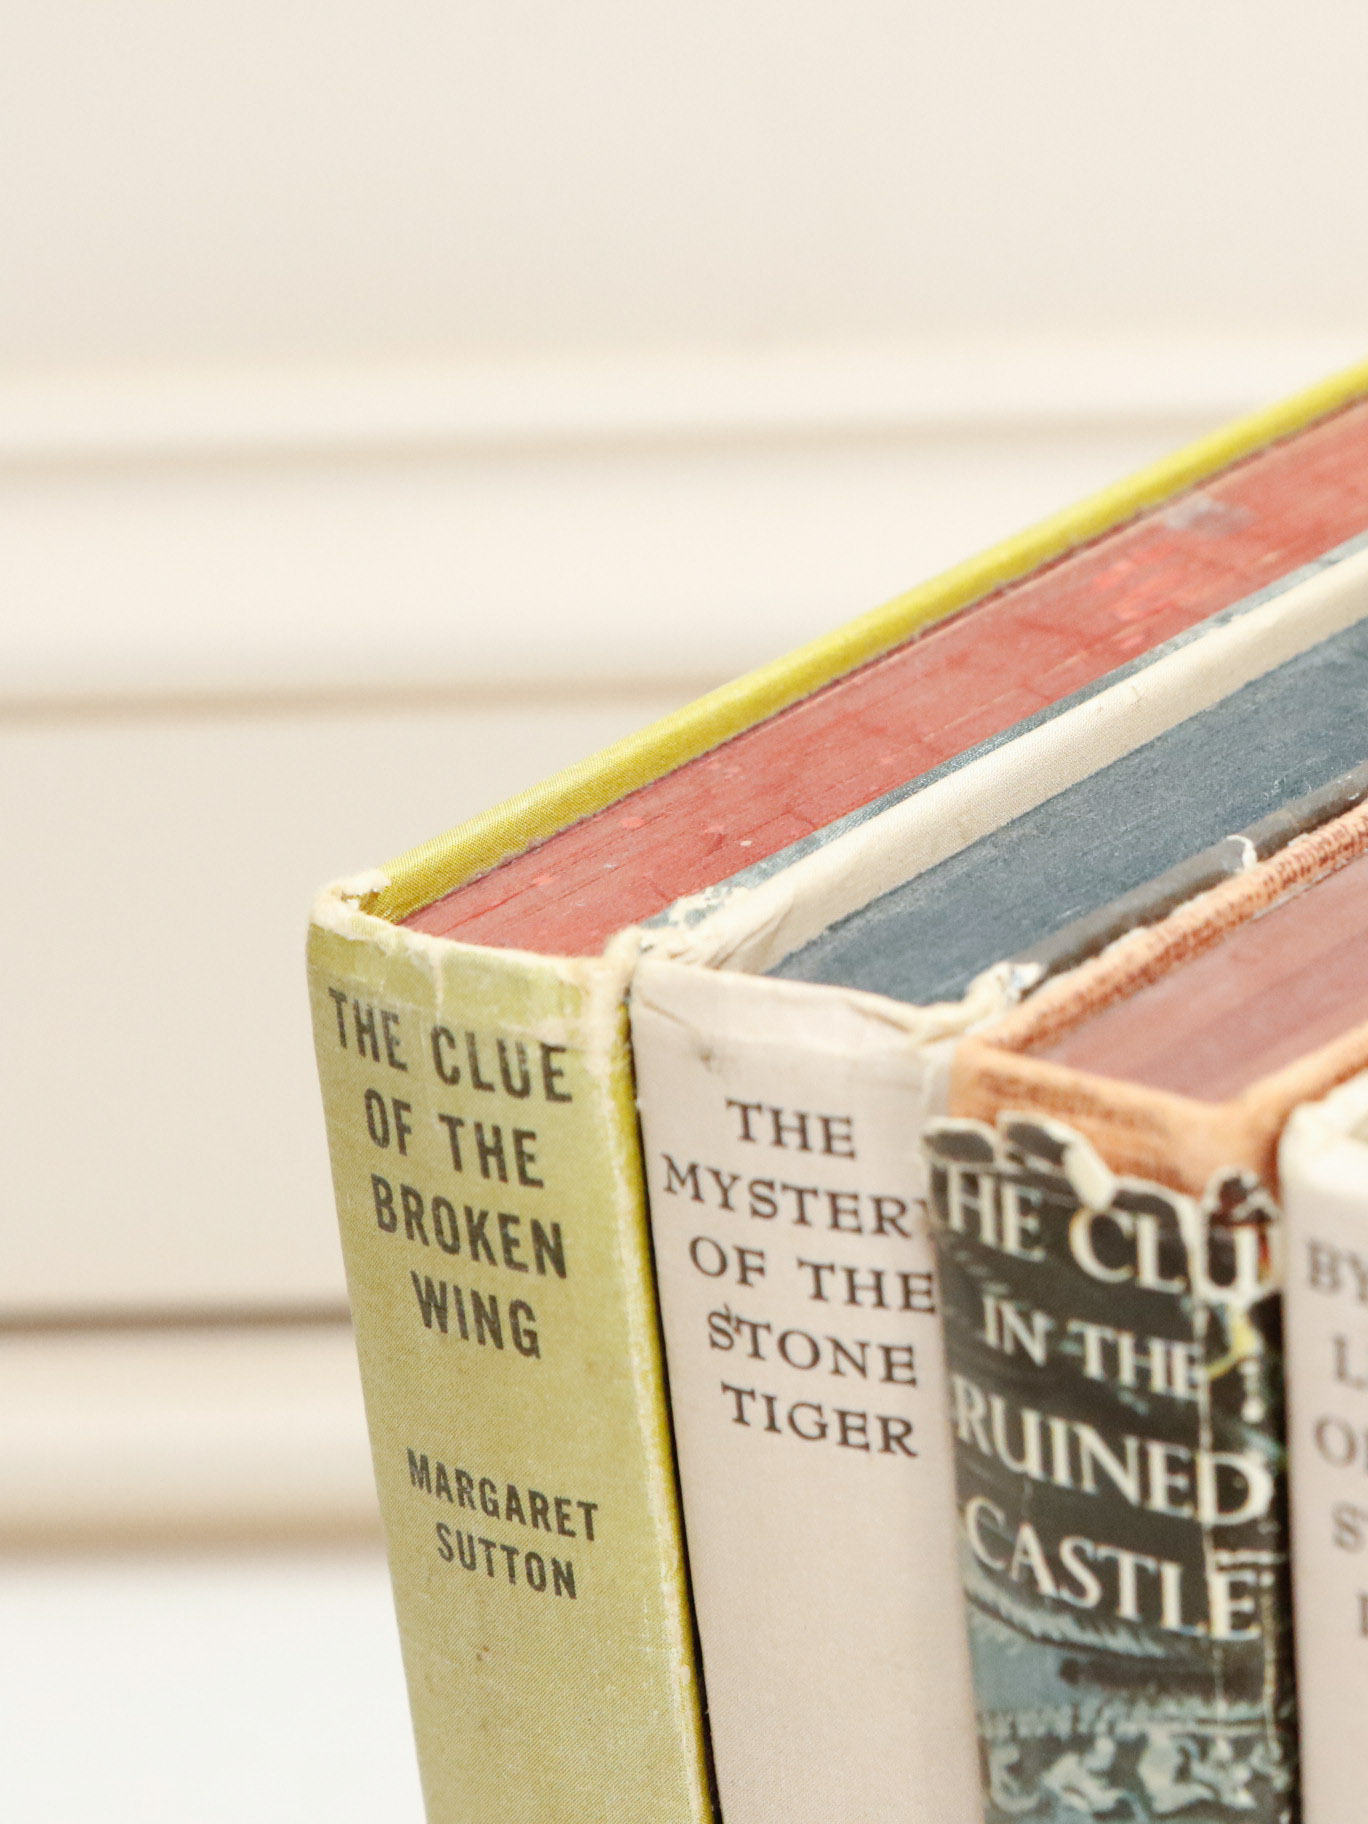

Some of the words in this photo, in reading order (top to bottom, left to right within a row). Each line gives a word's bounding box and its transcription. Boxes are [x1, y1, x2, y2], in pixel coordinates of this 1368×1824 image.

[328, 987, 408, 1074] THE
[430, 1024, 574, 1103] CLUE
[364, 1088, 413, 1157] OF
[439, 1113, 546, 1189] THE
[725, 1097, 857, 1161] THE
[370, 1173, 567, 1280] BROKEN
[688, 1235, 765, 1289] OF
[797, 1257, 937, 1316] THE
[945, 1163, 1046, 1263] HE
[1069, 1207, 1265, 1303] CLU
[410, 1270, 541, 1360] WING
[706, 1307, 918, 1388] STONE
[979, 1292, 1052, 1368] IN
[1067, 1319, 1209, 1402] THE
[721, 1381, 918, 1458] TIGER
[951, 1373, 1273, 1526] RUINED
[406, 1446, 598, 1543] MARGARET
[436, 1521, 577, 1601] SUTTON
[964, 1496, 1262, 1641] CASTLE
